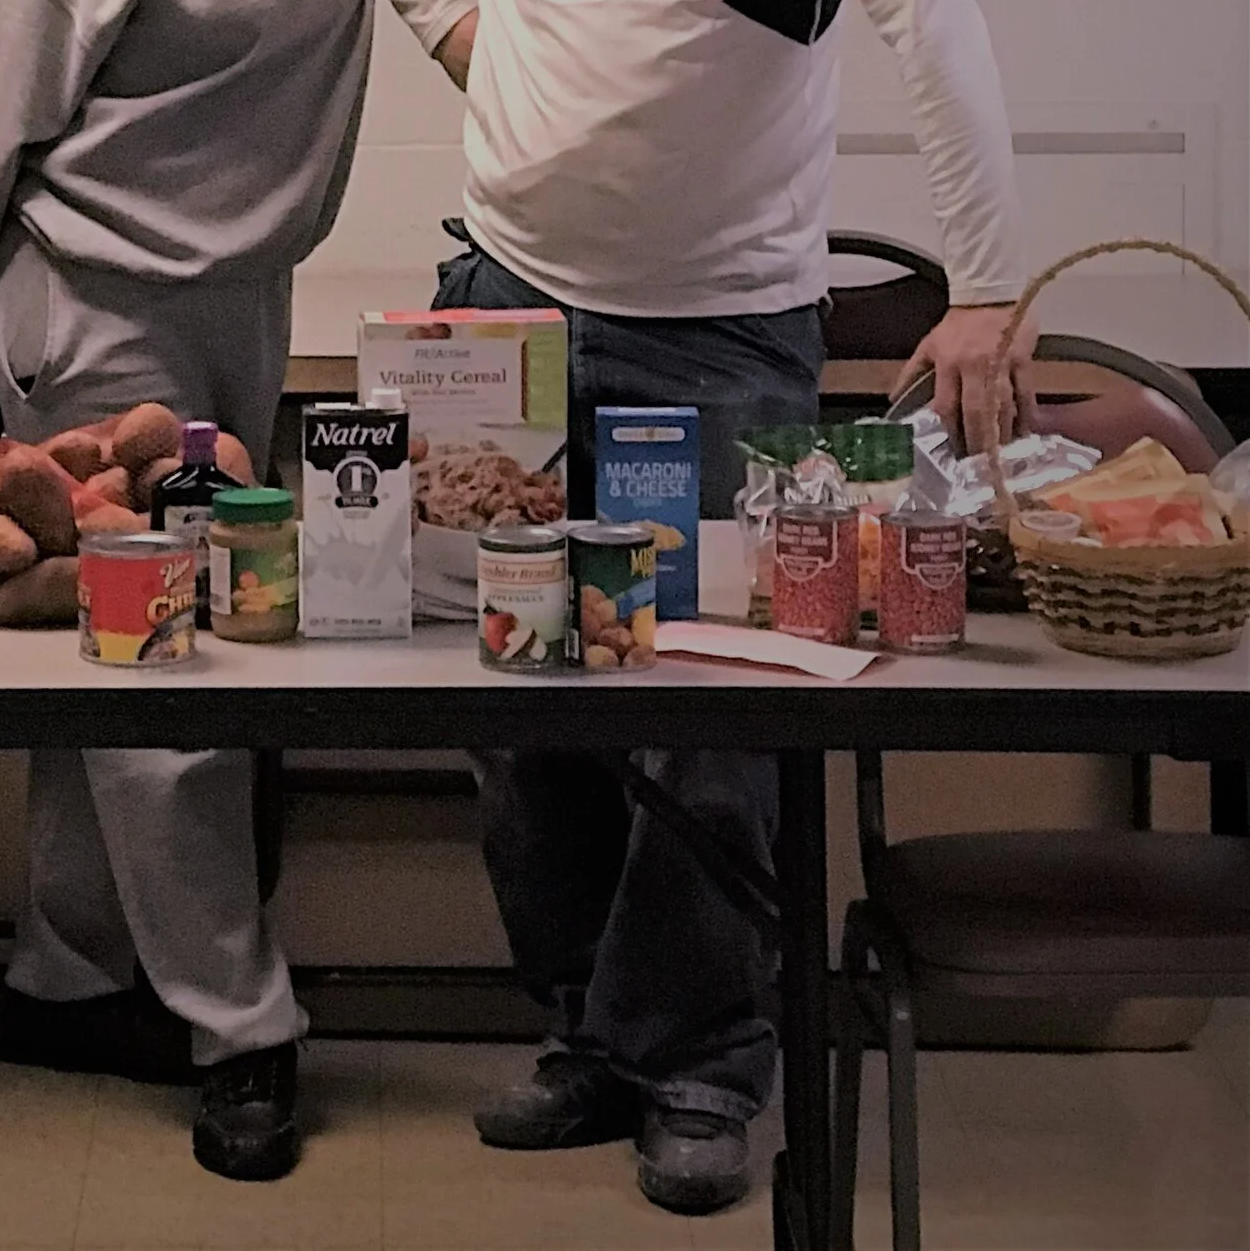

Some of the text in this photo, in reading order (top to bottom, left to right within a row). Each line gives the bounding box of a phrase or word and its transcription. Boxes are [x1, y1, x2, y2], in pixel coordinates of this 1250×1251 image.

[380, 367, 507, 388] Vitality Cereal
[310, 422, 398, 447] Natrel
[605, 461, 692, 480] MACARONI
[609, 480, 688, 498] & CHEESE
